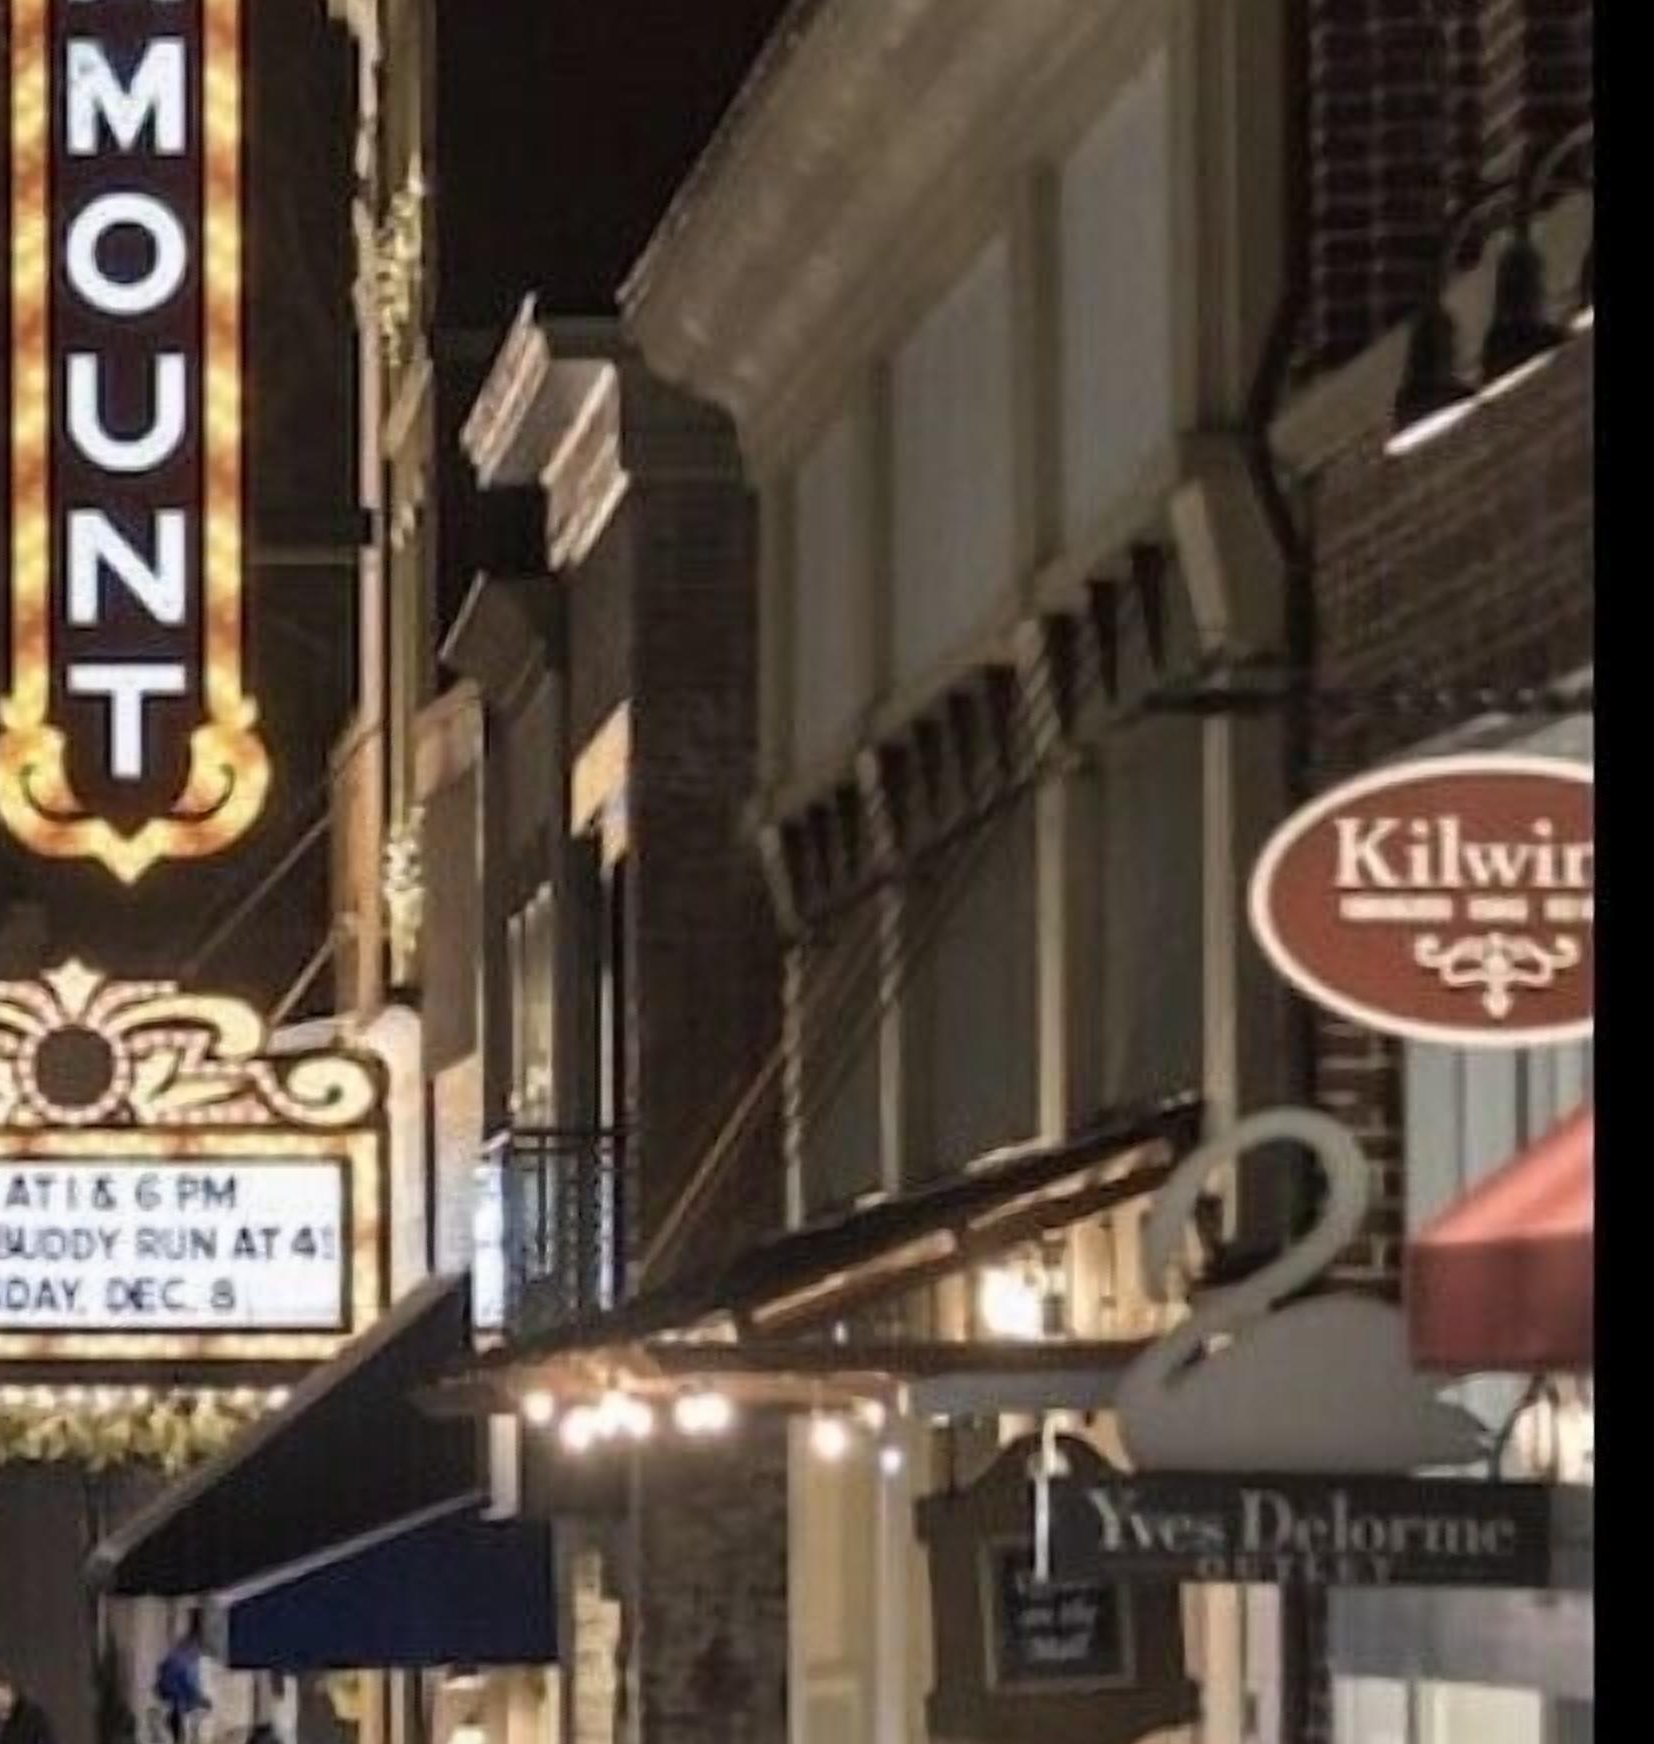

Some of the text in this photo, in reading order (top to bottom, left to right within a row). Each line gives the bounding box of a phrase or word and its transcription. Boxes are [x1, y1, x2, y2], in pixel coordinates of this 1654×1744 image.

[90, 1172, 117, 1211] &
[134, 1172, 162, 1211] 6
[175, 1173, 237, 1209] PM
[134, 1225, 218, 1260] RUN
[232, 1225, 281, 1260] AT
[209, 1276, 237, 1312] 8
[1086, 1485, 1517, 1555] Yves Delorme
